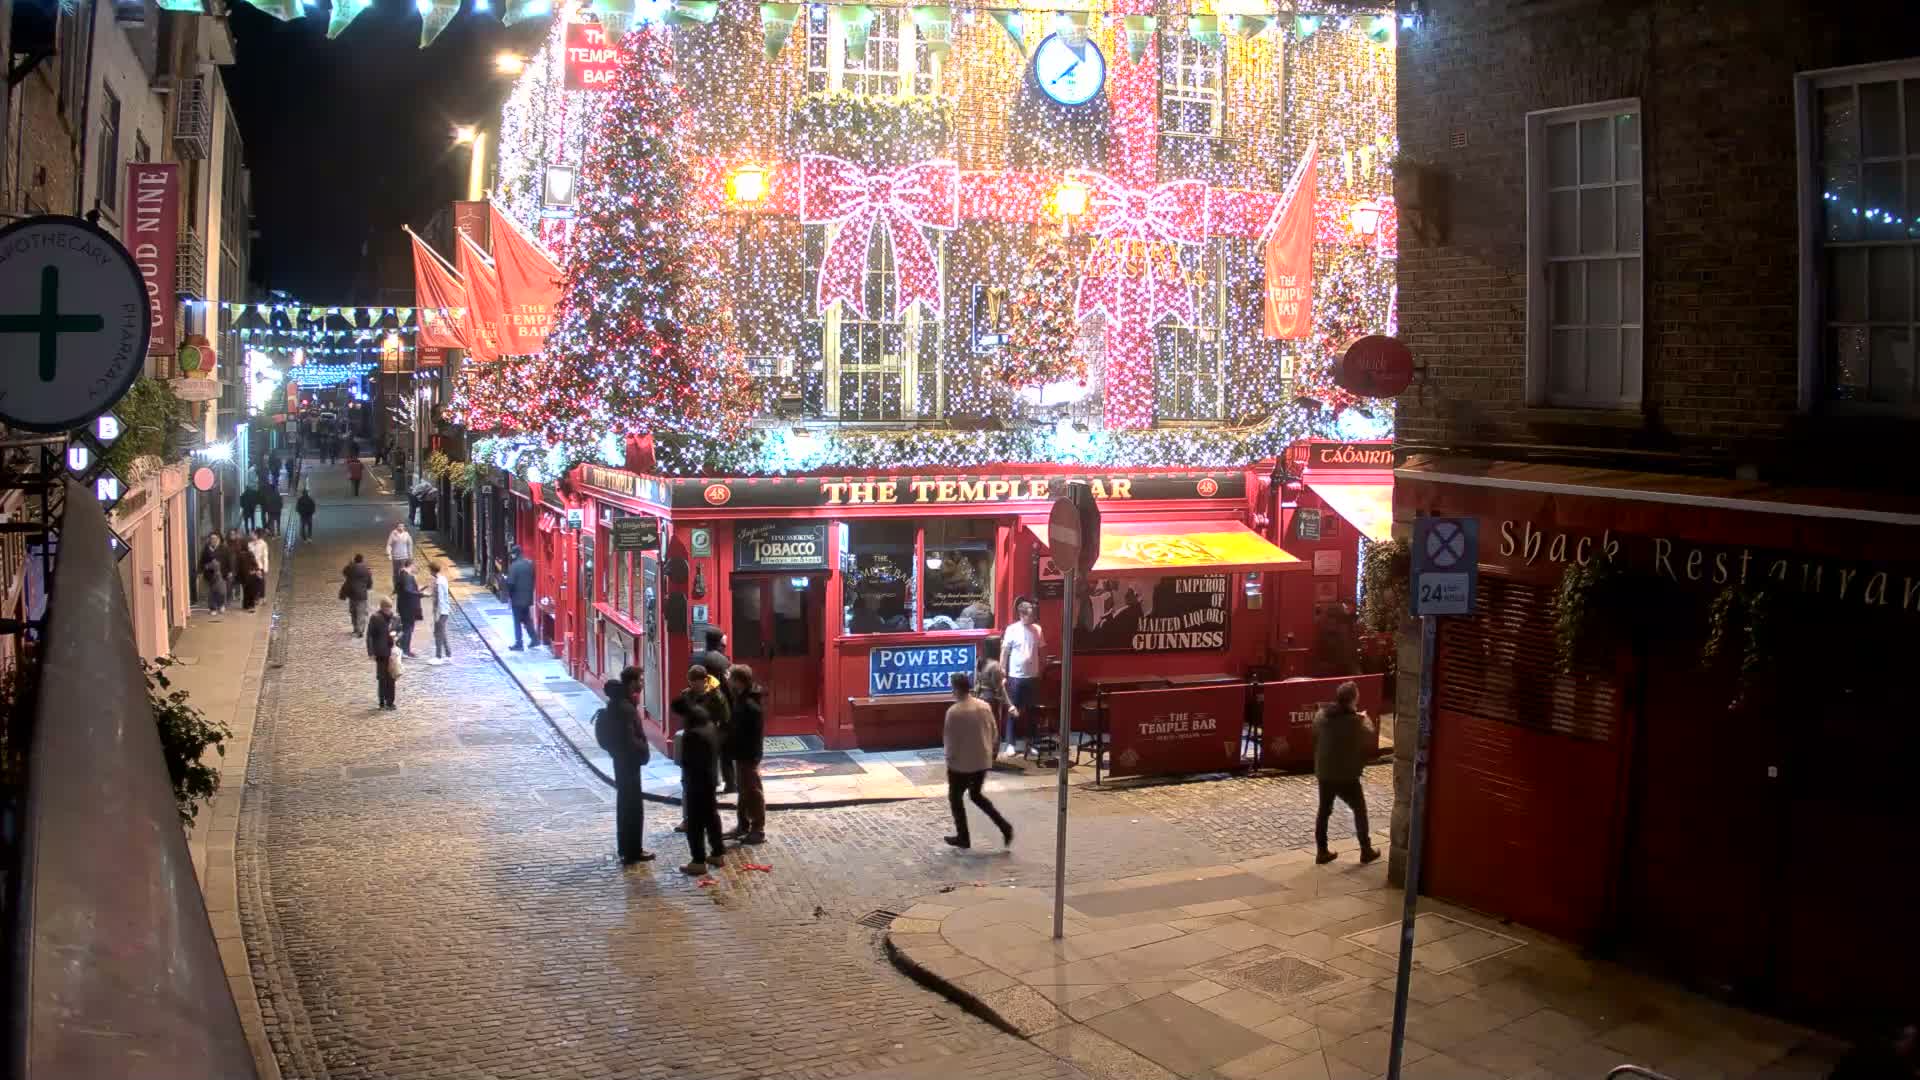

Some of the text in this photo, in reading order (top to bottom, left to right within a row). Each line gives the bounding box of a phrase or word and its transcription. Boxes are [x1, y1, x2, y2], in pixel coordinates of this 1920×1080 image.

[584, 29, 606, 44] TH
[137, 171, 169, 232] NINE
[1088, 238, 1178, 262] MERRY
[521, 305, 546, 313] THE
[708, 488, 725, 501] 48
[822, 481, 898, 504] THE
[911, 479, 1049, 502] TEMPLE
[749, 538, 815, 562] TOBACCO
[873, 555, 889, 563] THE
[1176, 578, 1226, 593] EMPEROR
[1421, 584, 1442, 603] 24
[1211, 593, 1225, 608] OF
[1138, 608, 1226, 632] MALTED LIQUORS
[1132, 631, 1224, 650] GUINNESS
[880, 648, 968, 668] POWER'S
[1169, 712, 1188, 721] THE
[1138, 718, 1217, 735] TEMPLE BAR
